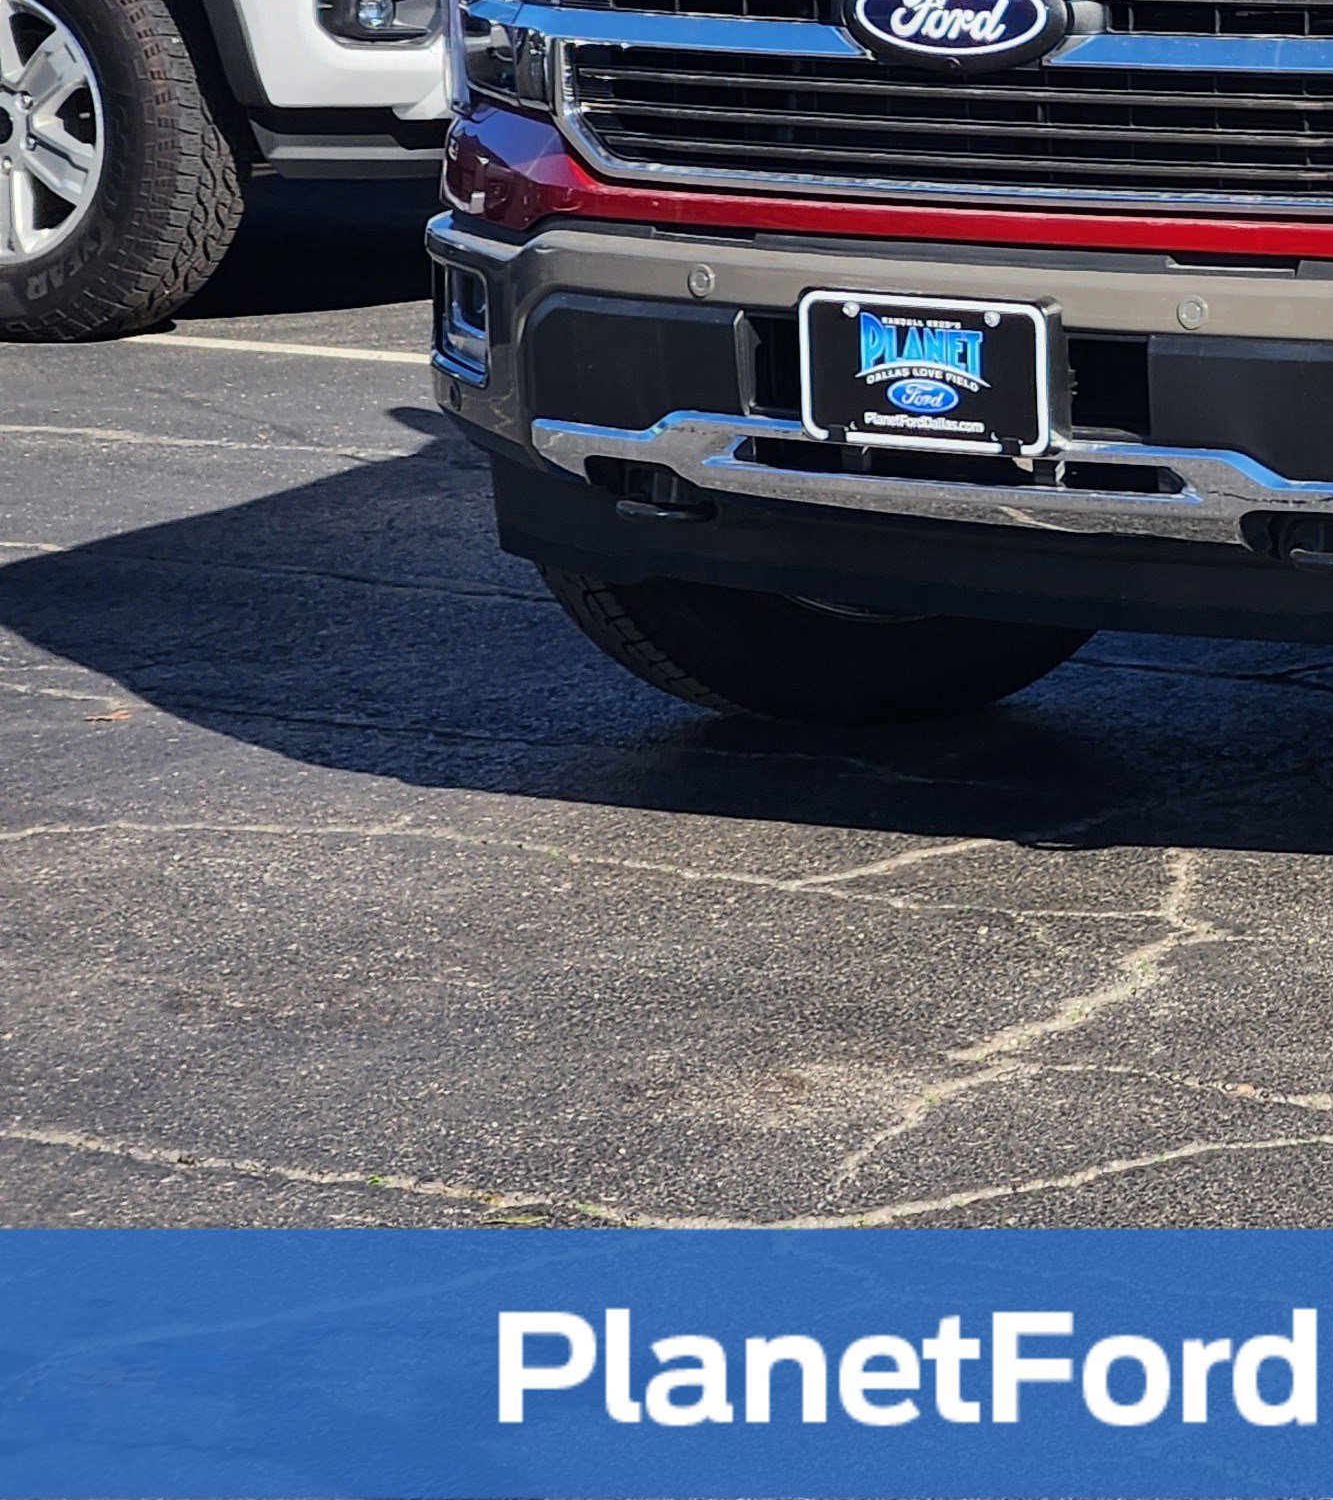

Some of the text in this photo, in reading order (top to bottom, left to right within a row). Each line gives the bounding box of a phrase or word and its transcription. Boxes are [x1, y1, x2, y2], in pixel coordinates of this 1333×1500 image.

[860, 311, 983, 380] PLANET
[866, 367, 980, 393] DALLAS LOVE FIELD
[901, 383, 945, 407] Ford
